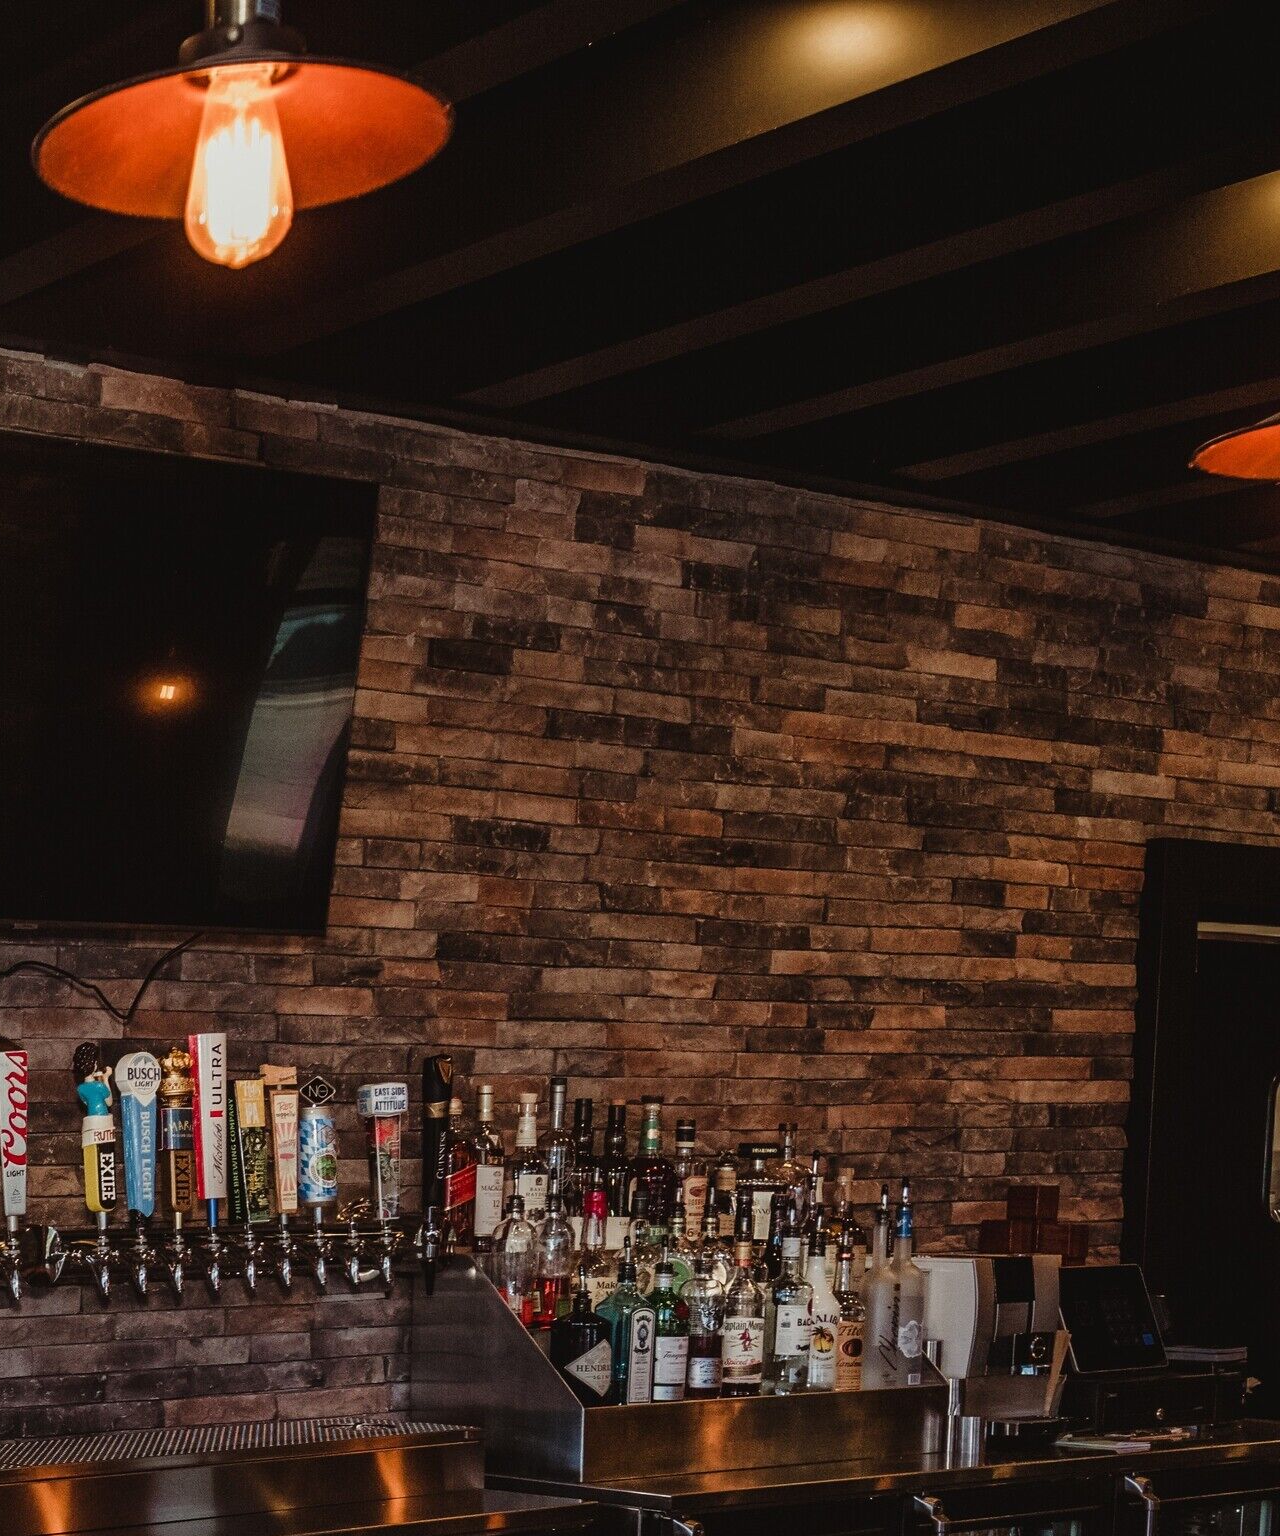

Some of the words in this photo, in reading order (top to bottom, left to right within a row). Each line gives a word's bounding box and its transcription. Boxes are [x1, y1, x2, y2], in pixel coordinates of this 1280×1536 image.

[127, 1067, 161, 1081] BUSCH
[212, 1043, 222, 1106] ULTRA
[374, 1087, 389, 1097] EAST
[390, 1086, 406, 1096] SIDE
[1, 1051, 28, 1168] Coors
[228, 1098, 237, 1143] COMPANY
[374, 1100, 406, 1111] ATTITUDE
[140, 1111, 151, 1153] BUSCH
[6, 1169, 25, 1178] LIGHT
[213, 1123, 224, 1184] Michelob
[230, 1146, 239, 1186] BREWING
[141, 1158, 152, 1200] LIGHT
[232, 1188, 242, 1214] HILLS
[492, 1199, 501, 1208] 12
